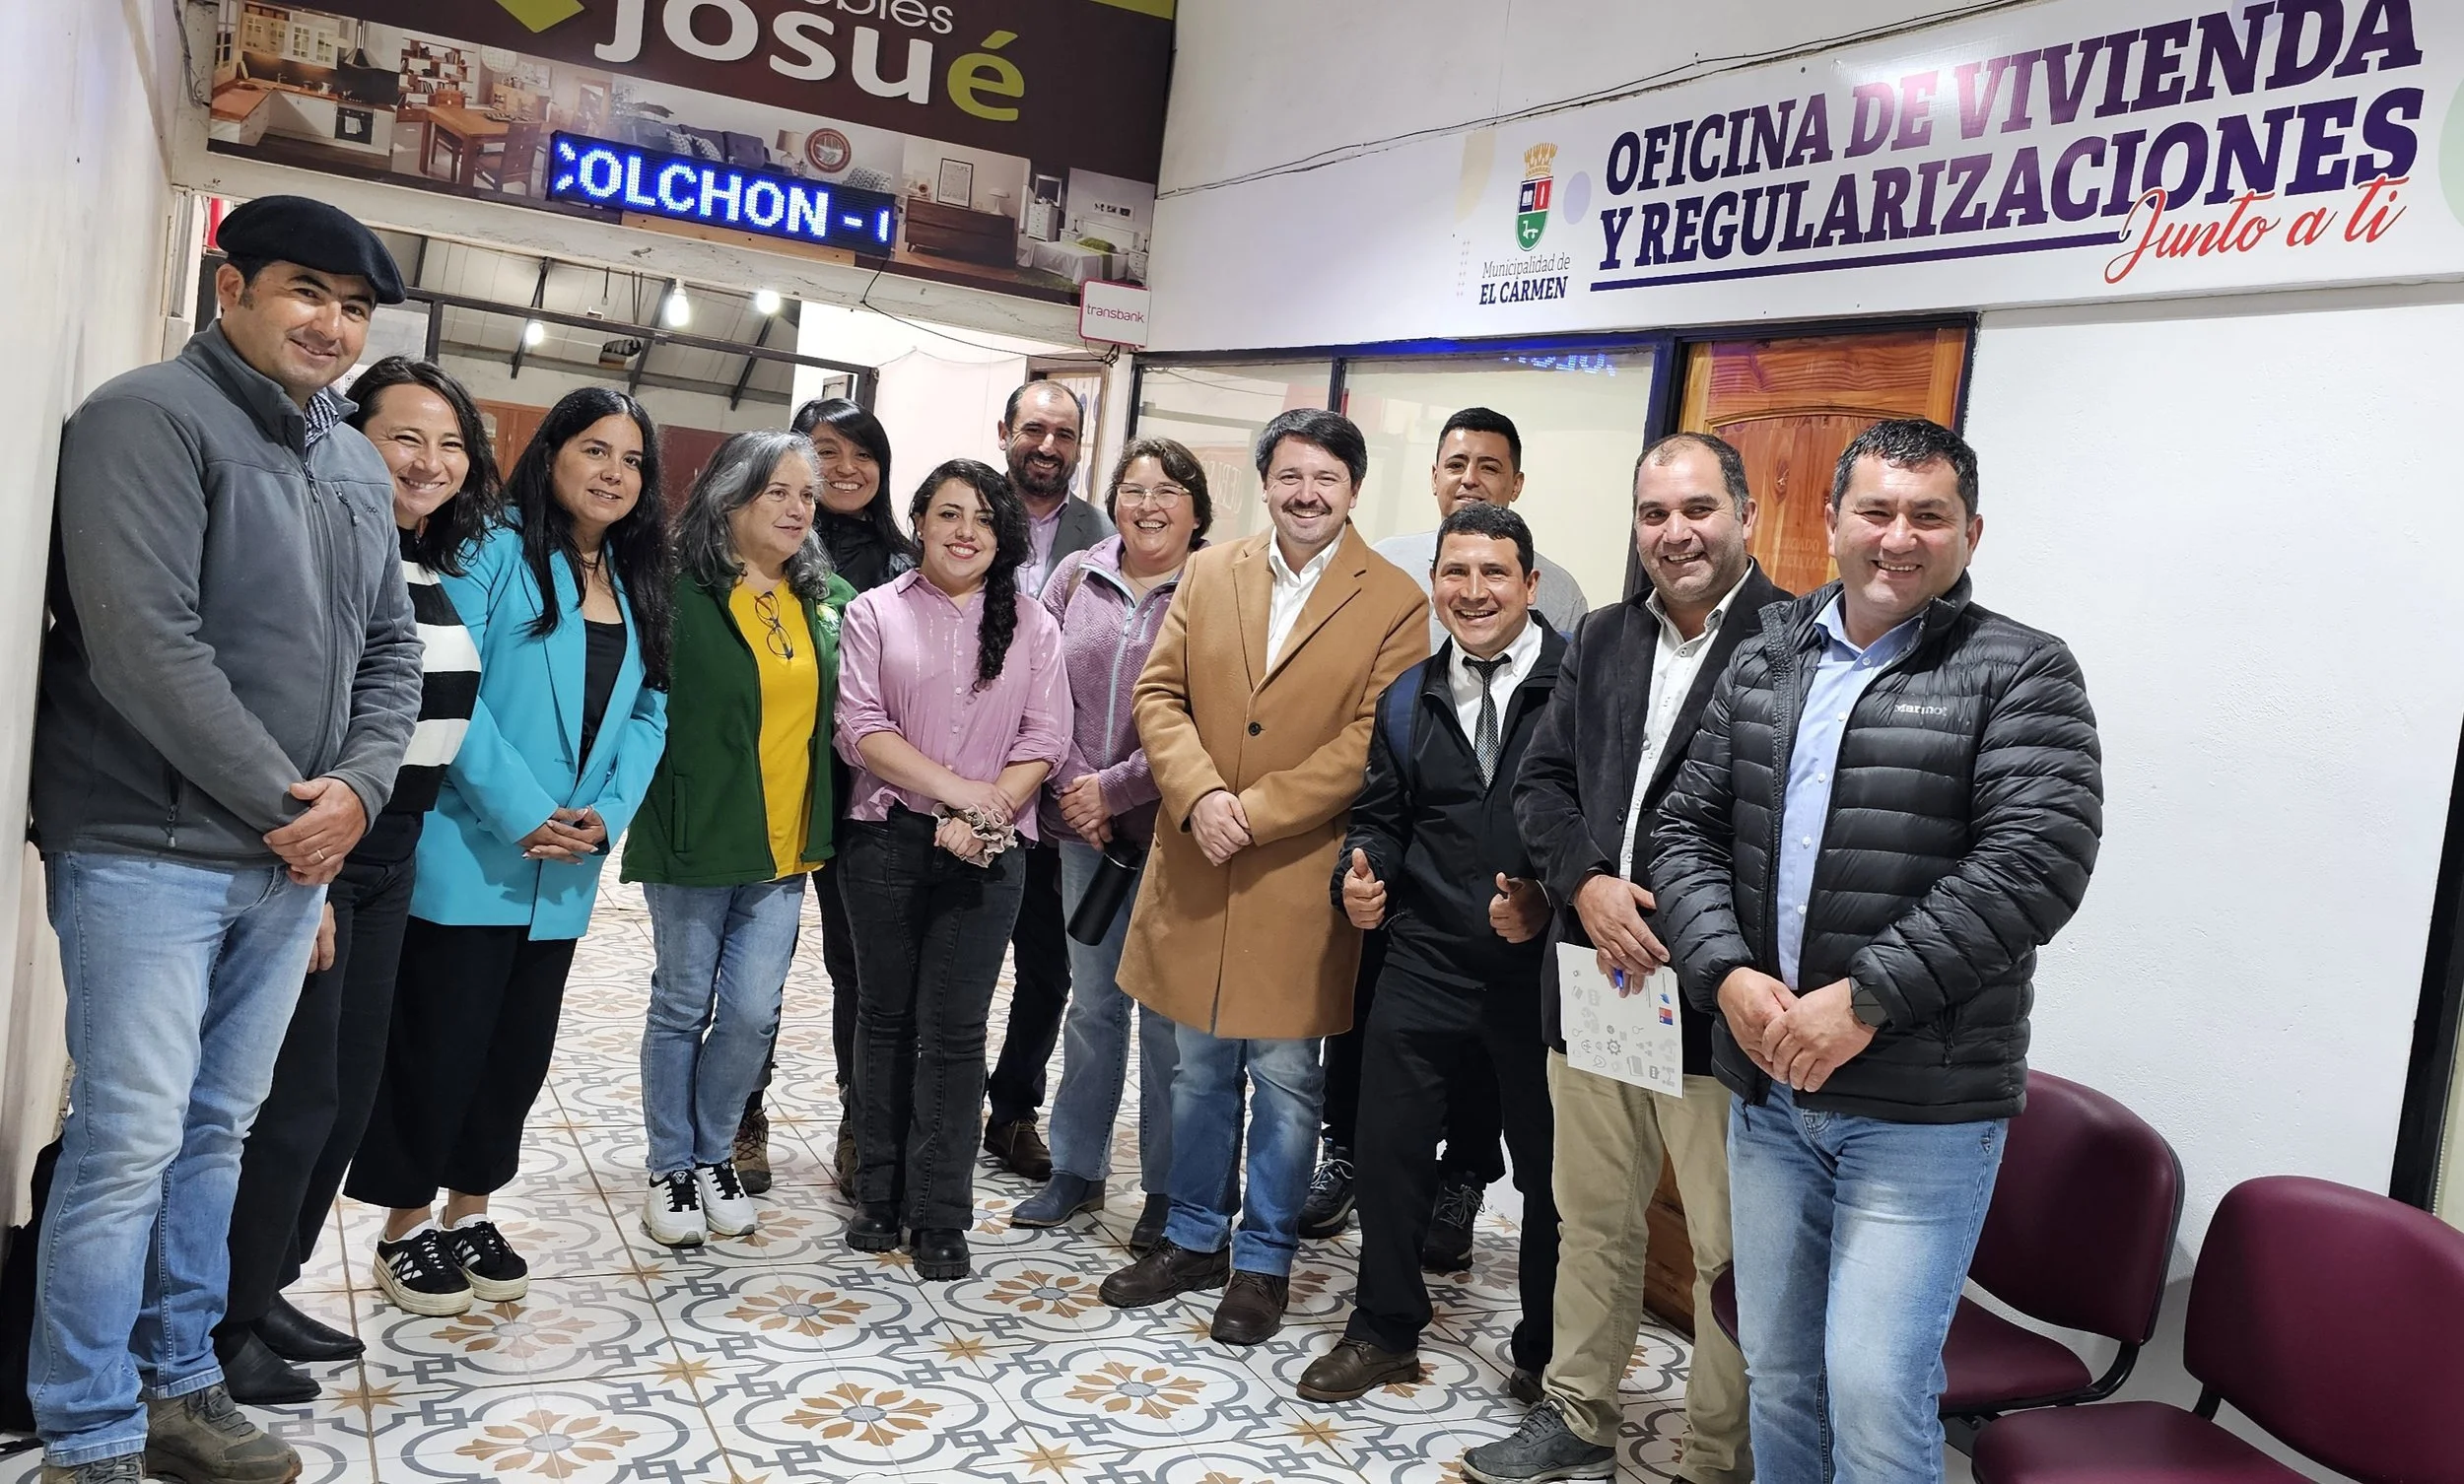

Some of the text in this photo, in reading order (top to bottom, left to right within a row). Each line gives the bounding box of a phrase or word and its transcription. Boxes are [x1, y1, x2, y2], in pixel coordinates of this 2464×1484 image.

[1606, 0, 2425, 196] OFICINA DE VIVIENDA
[558, 141, 830, 237] OLCHON
[1599, 87, 2426, 271] Y REGULARIZACIONES
[1481, 251, 1571, 279] Municipalidad de
[2104, 173, 2410, 285] Junto a ti
[1086, 303, 1145, 324] transbank
[1478, 276, 1569, 305] EL CARMEN
